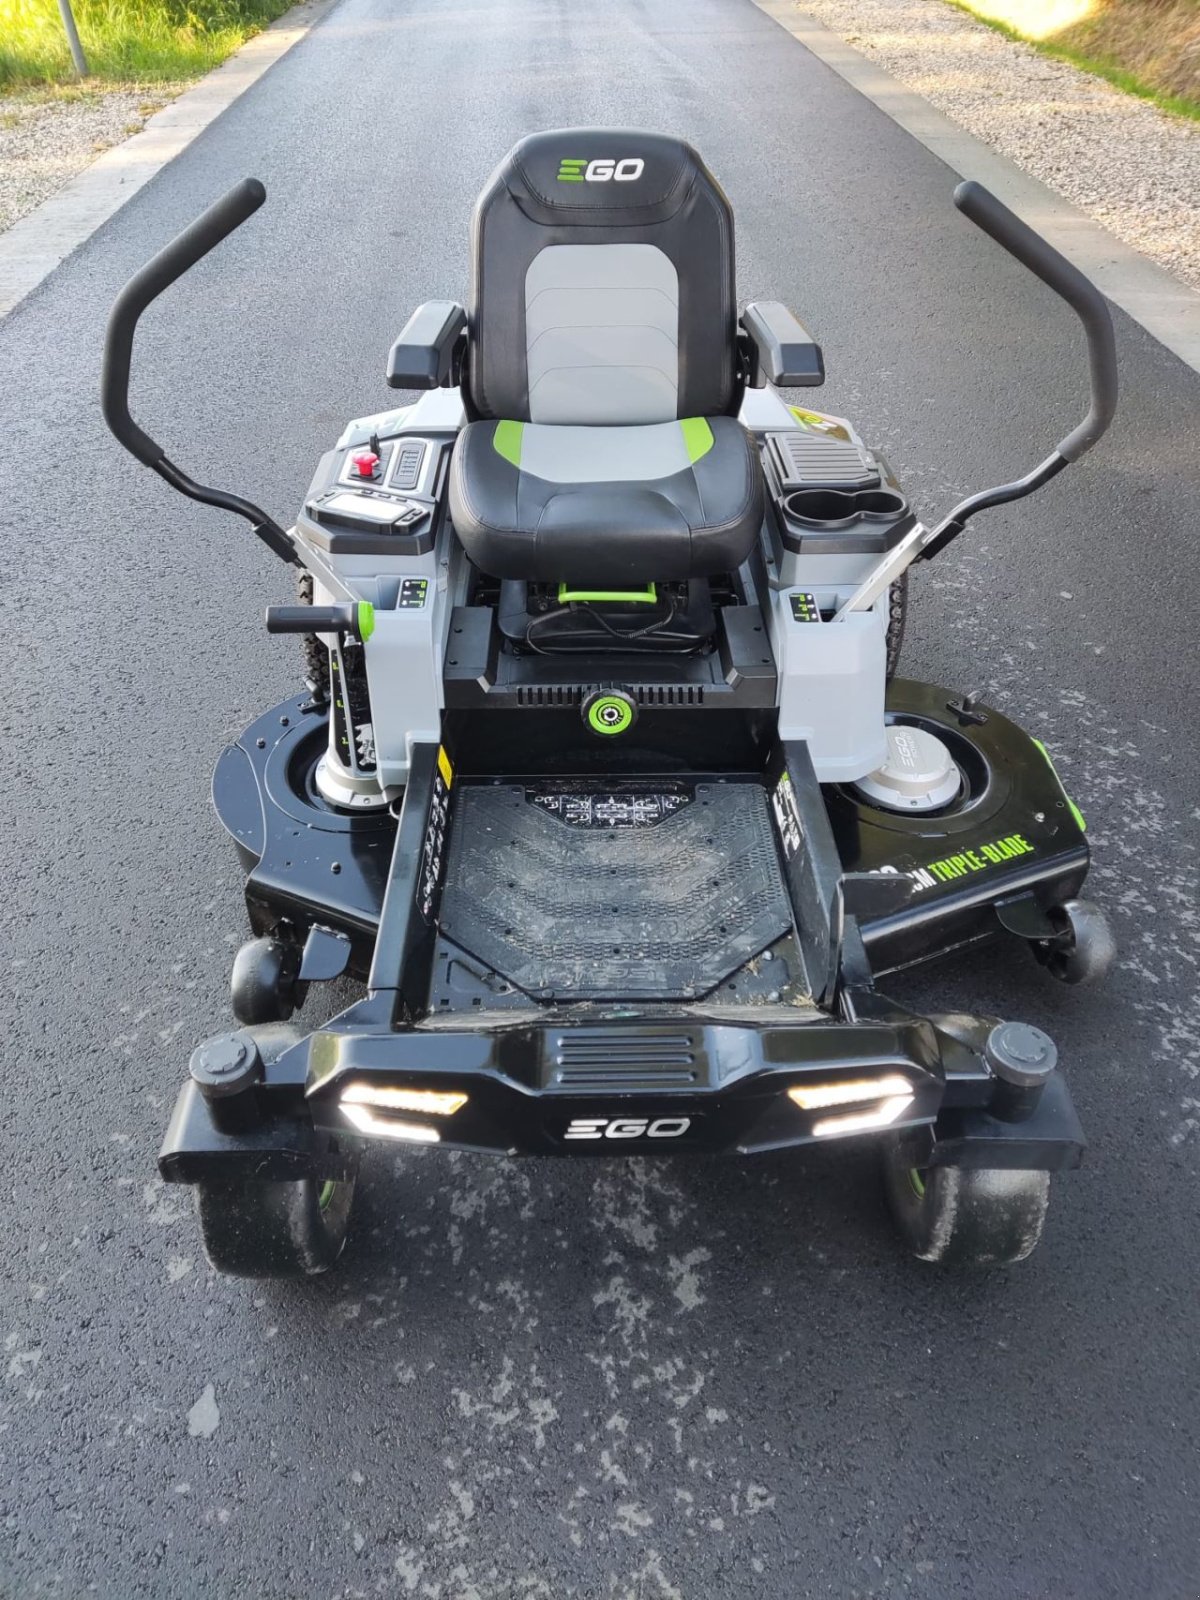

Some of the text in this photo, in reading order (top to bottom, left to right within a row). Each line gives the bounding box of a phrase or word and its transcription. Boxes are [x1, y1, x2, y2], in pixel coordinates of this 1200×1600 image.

[557, 158, 645, 181] EGO
[927, 834, 1034, 881] TRIPLE-BLADE
[563, 1117, 691, 1140] EGO
